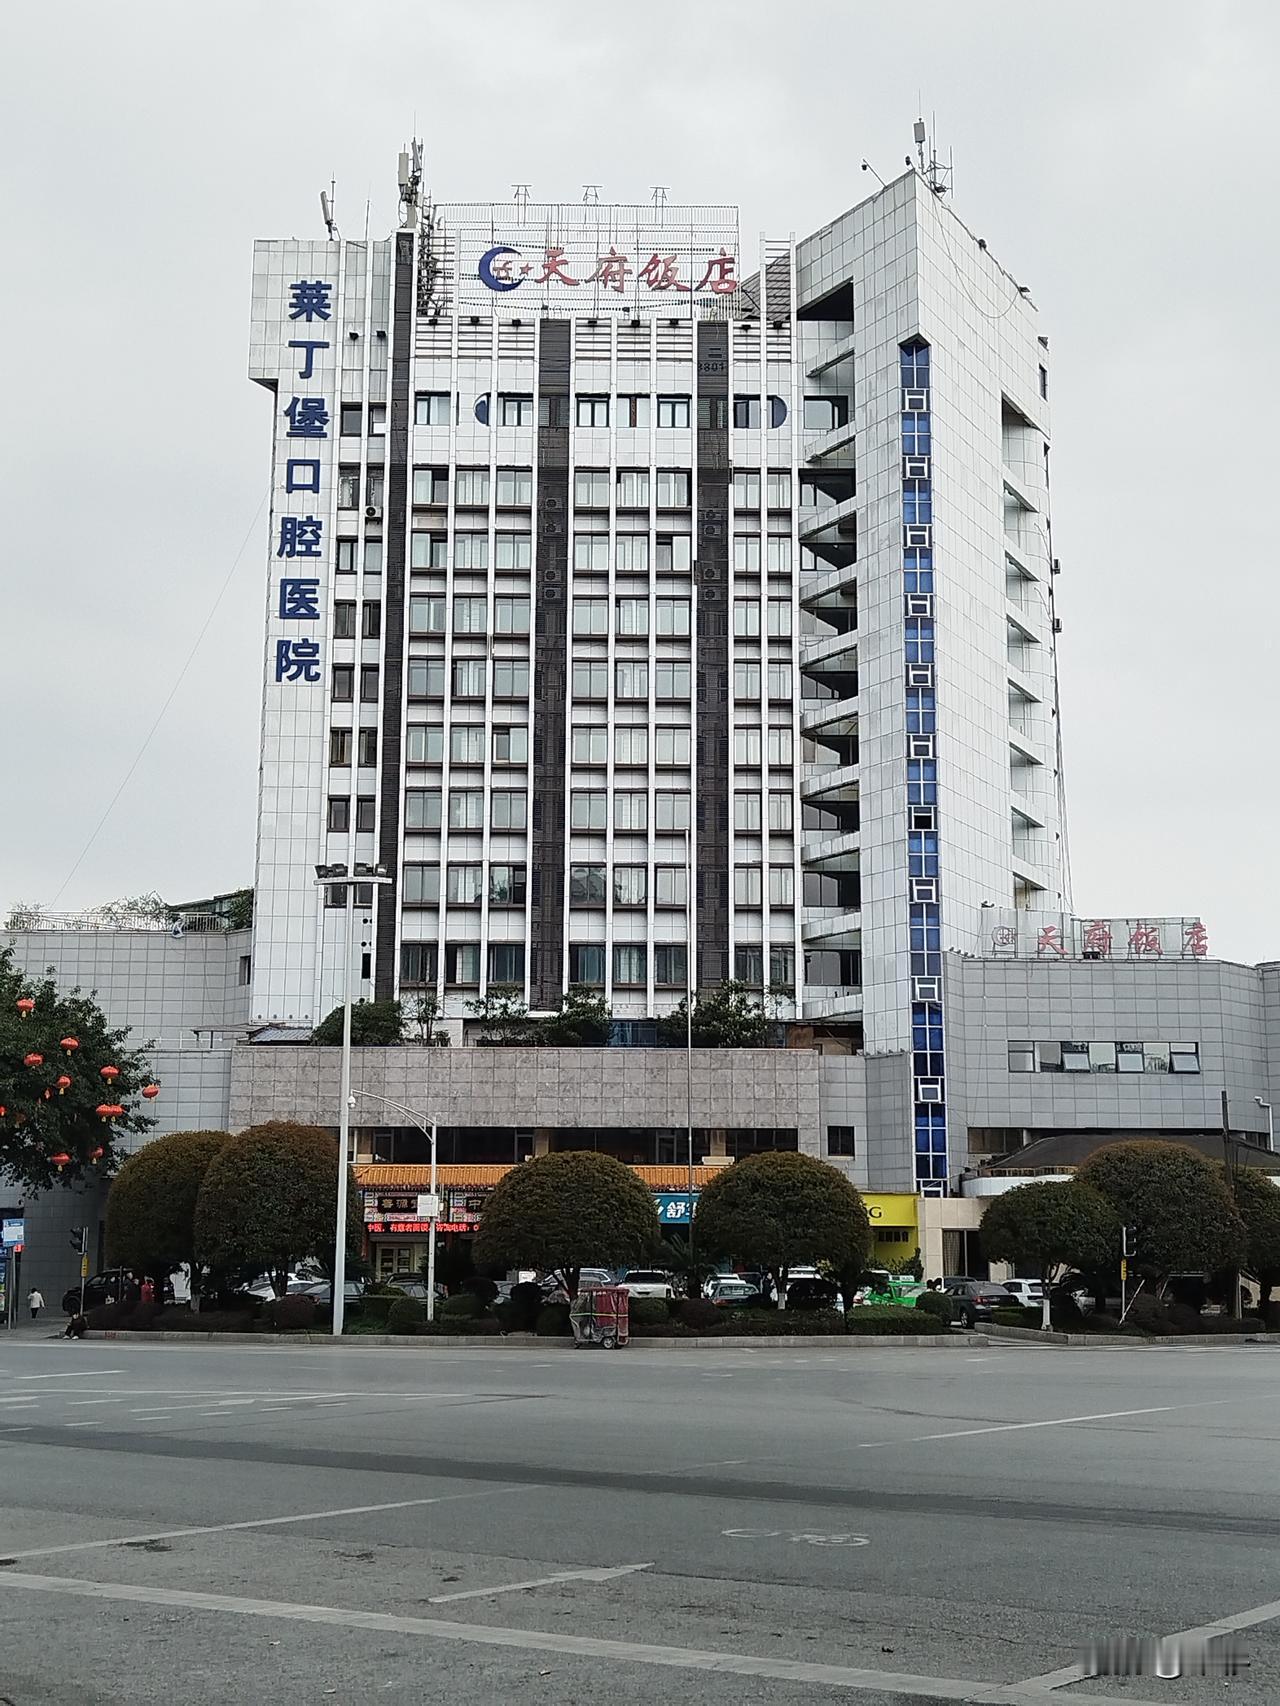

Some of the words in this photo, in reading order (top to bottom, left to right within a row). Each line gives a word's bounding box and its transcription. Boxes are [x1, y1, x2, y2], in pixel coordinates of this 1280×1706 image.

[534, 246, 738, 294] 天府饭店
[275, 280, 332, 684] 莱丁堡口腔医院
[1037, 919, 1209, 957] 天府饭店
